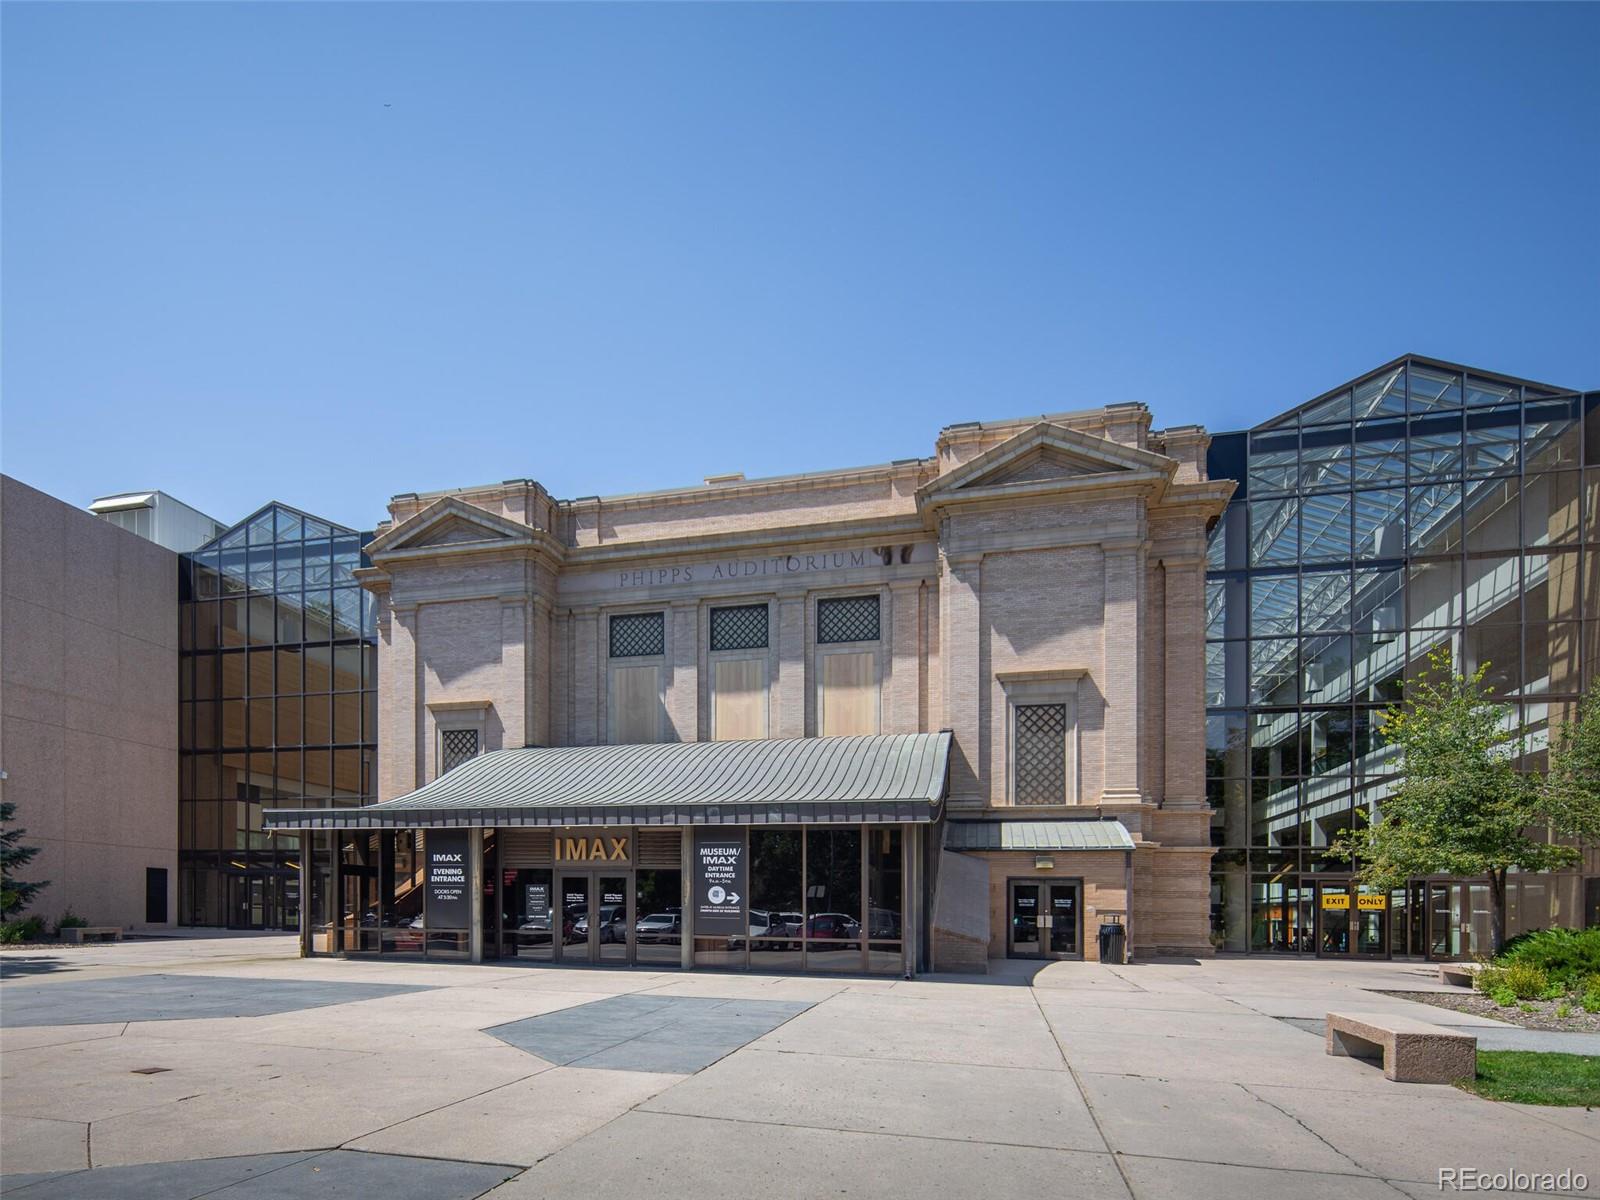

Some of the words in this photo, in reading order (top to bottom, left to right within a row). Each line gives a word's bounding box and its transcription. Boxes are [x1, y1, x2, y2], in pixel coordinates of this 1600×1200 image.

[619, 566, 693, 587] PHIPPS
[712, 551, 865, 579] AUDITORIUM
[555, 838, 628, 861] IMAX
[700, 848, 741, 856] MUSEUM/
[433, 854, 462, 862] IMAX
[703, 856, 737, 864] IMAX
